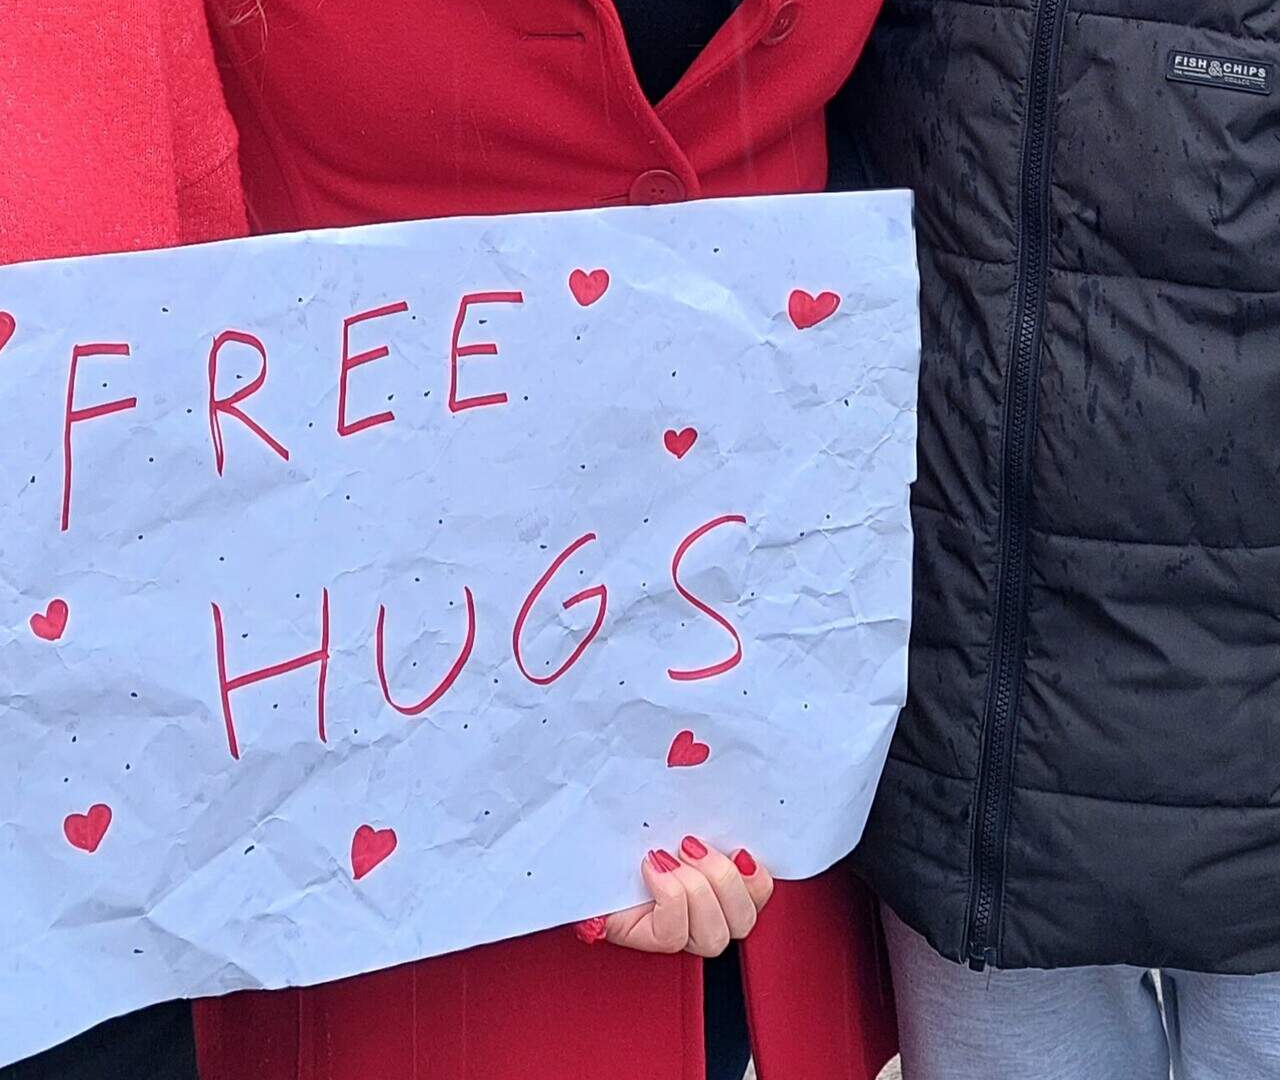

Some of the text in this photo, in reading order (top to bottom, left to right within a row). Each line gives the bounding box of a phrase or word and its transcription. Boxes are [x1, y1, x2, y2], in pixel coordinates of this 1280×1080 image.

[1175, 55, 1266, 78] FISH & CHIPS
[60, 291, 524, 532] FREE
[211, 514, 747, 760] HUGS
